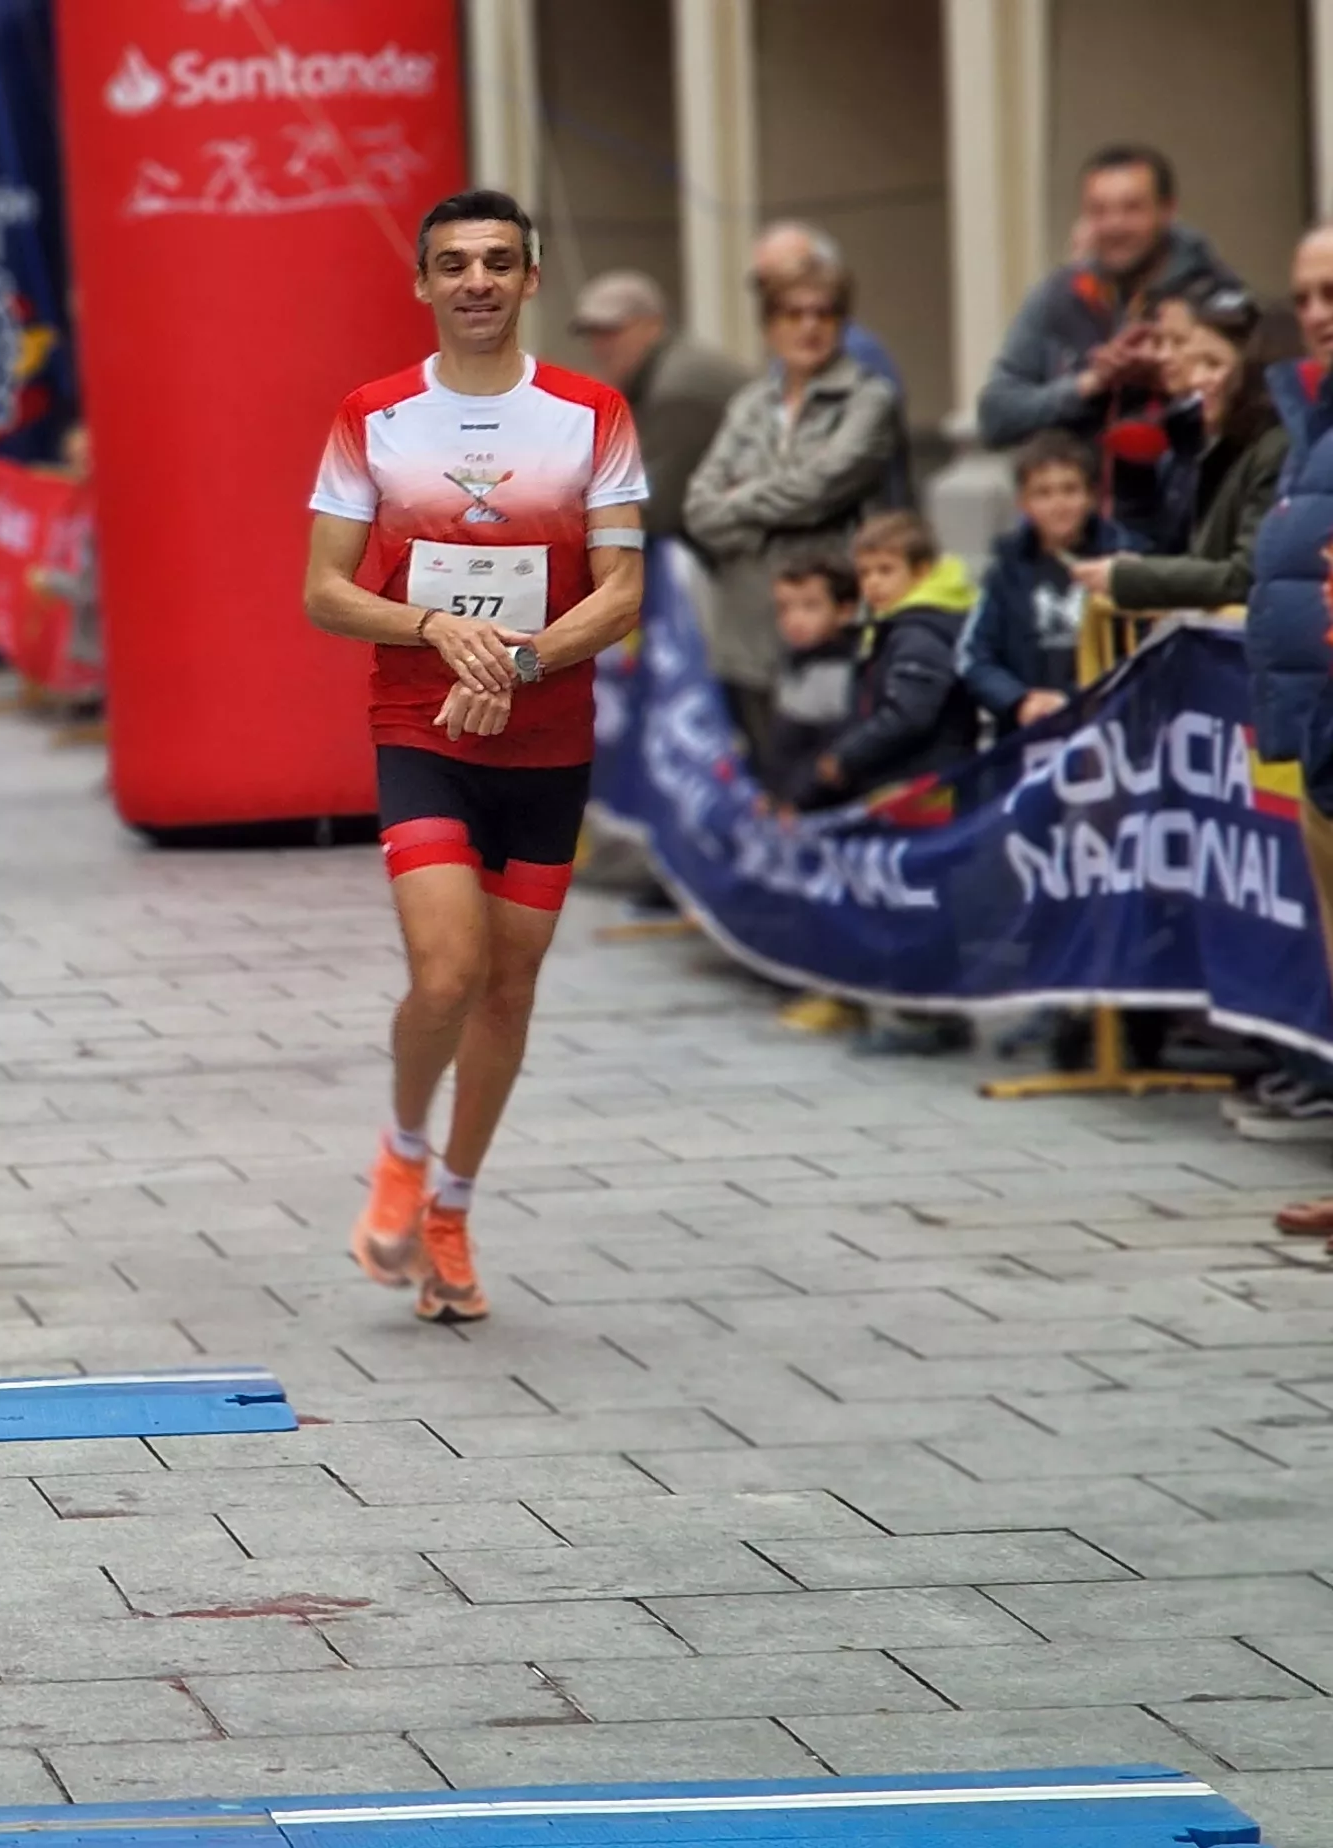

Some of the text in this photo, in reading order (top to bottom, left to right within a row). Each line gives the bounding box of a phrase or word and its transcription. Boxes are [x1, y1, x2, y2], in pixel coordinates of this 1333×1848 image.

[168, 44, 435, 104] Santander
[451, 595, 504, 618] 577
[1005, 810, 1307, 930] NACIONAL
